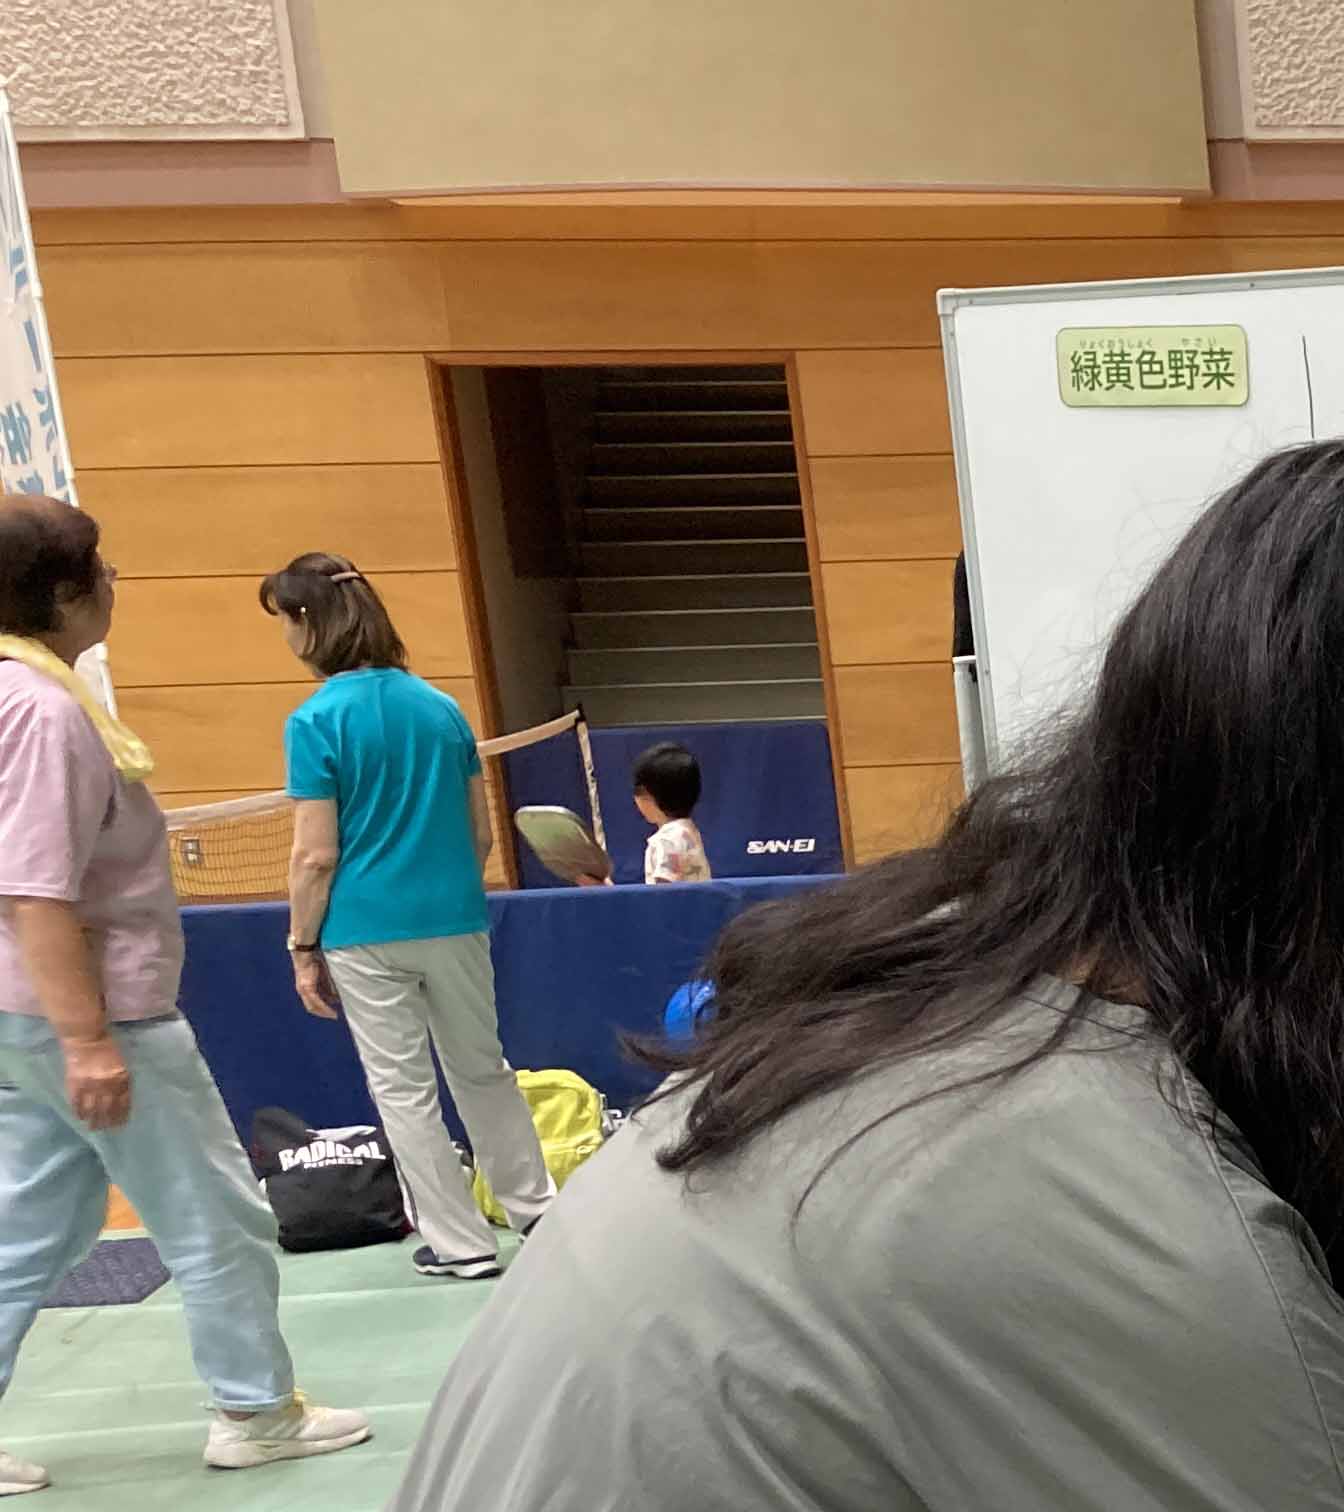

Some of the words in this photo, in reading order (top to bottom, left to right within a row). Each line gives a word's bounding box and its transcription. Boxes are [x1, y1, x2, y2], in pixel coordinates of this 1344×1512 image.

[1070, 347, 1235, 391] 緑黄色野菜
[278, 1140, 387, 1172] RADICAL
